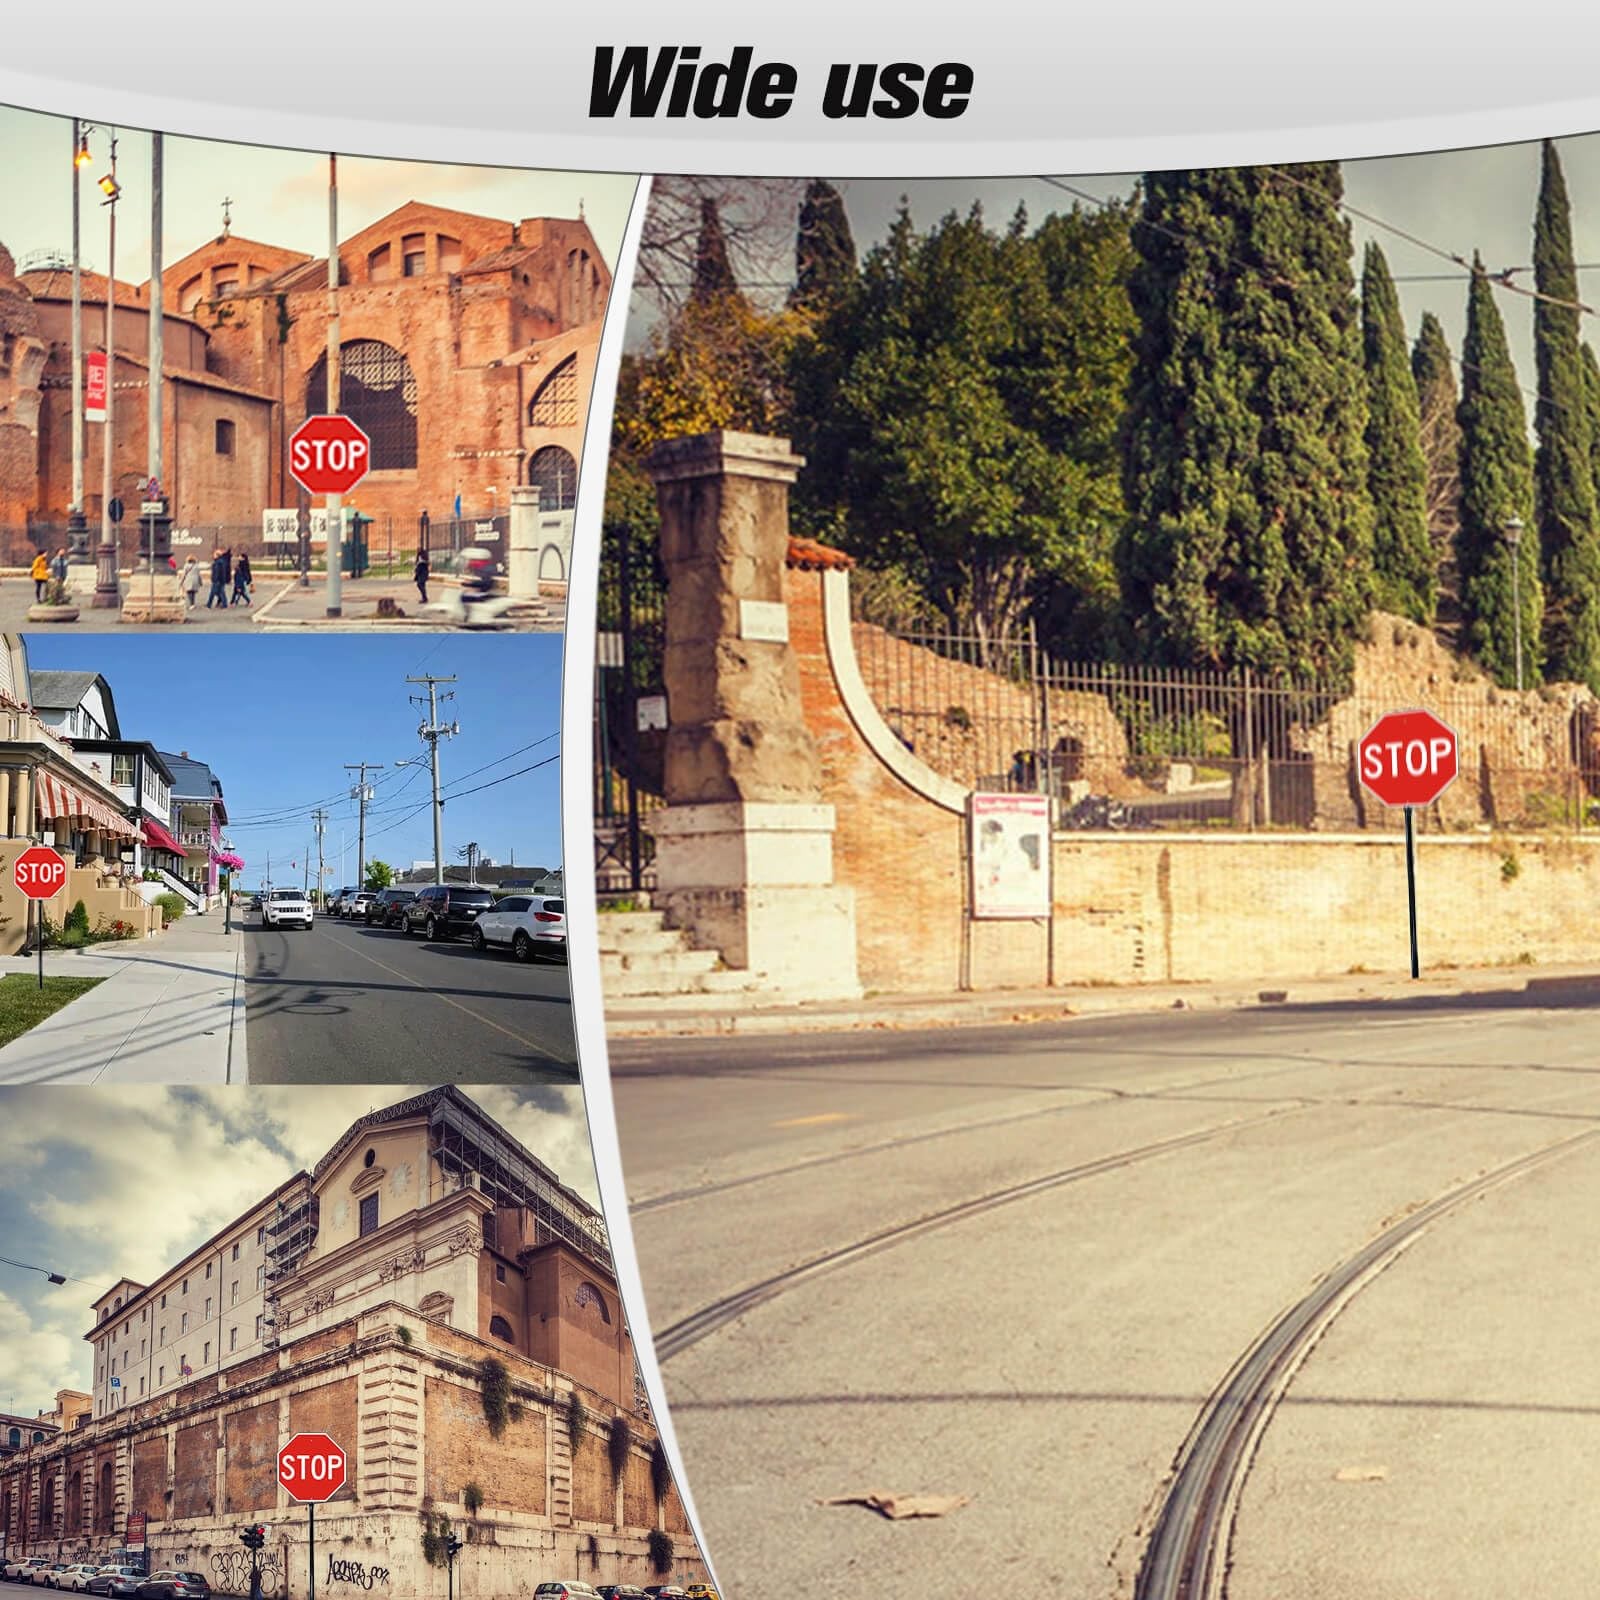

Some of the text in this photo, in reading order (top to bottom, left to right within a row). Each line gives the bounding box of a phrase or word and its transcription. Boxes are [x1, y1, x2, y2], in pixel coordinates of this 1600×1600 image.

[293, 439, 366, 471] STOP
[1364, 737, 1452, 780] STOP
[17, 863, 64, 883] STOP
[281, 1454, 343, 1481] STOP
